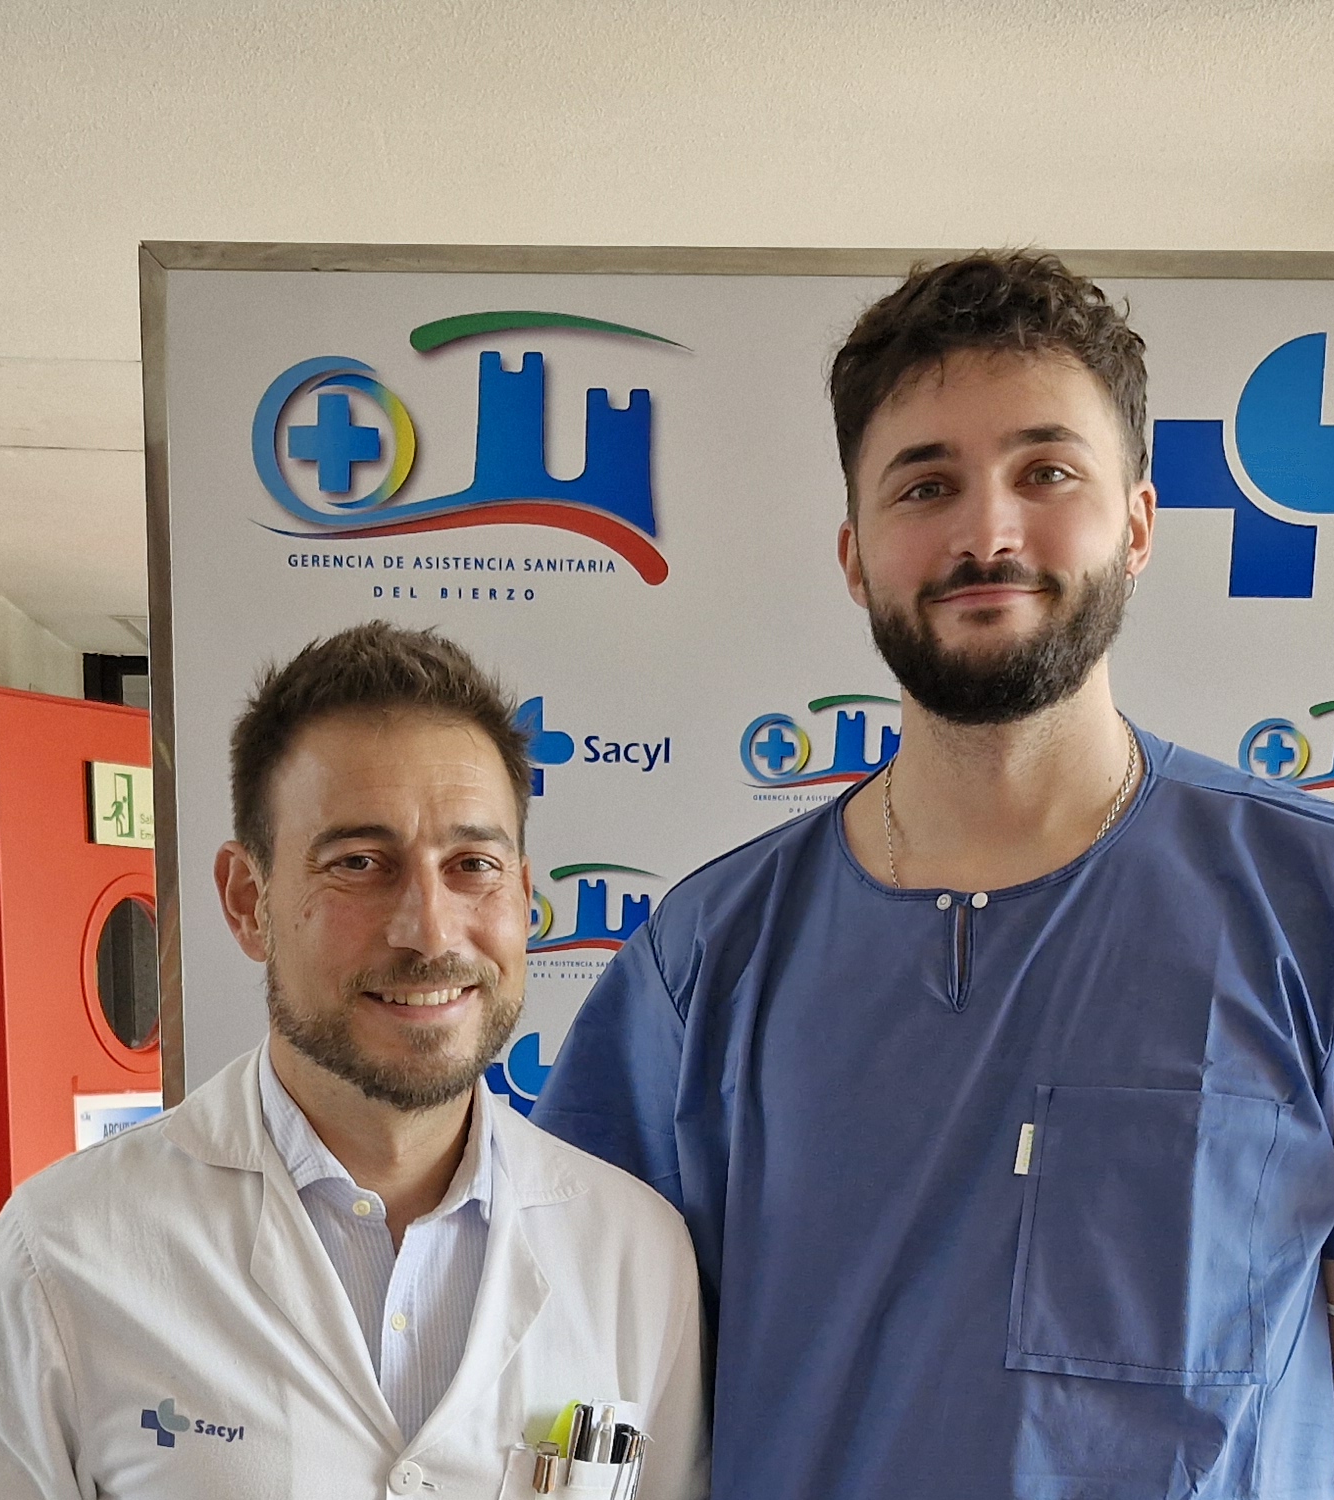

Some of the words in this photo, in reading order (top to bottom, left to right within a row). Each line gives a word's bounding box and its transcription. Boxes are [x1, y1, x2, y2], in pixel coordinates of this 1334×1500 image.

[287, 553, 375, 569] GERENCIA
[383, 555, 405, 570] DE
[412, 556, 516, 571] ASISTENCIA
[523, 558, 617, 573] SANITARIA
[373, 586, 418, 599] DEL
[440, 587, 536, 601] BIERZO
[583, 734, 672, 772] Sacyl
[549, 960, 593, 968] ASISTENCIA
[193, 1419, 245, 1443] Sacyl
